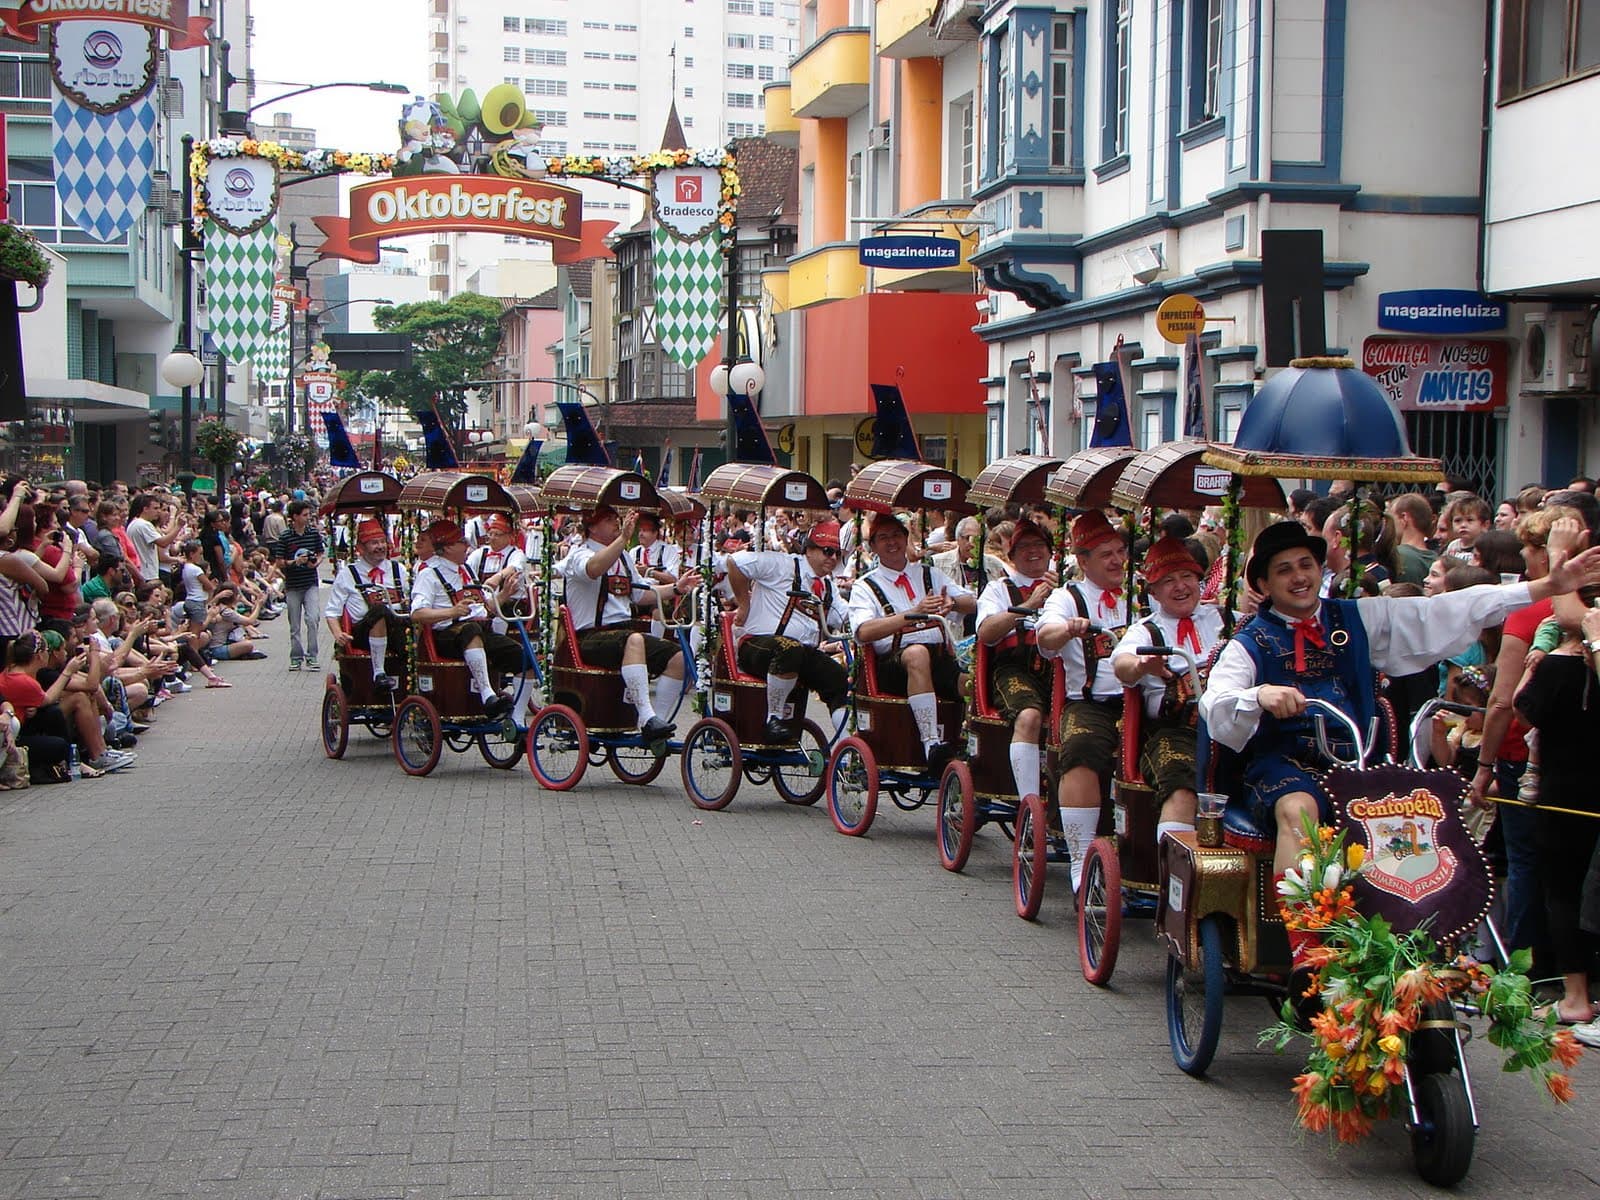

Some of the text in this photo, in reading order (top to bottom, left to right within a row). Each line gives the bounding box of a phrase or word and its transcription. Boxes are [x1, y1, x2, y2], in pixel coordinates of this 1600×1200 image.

[367, 184, 567, 229] Oktoberfest
[663, 206, 714, 216] Bradesco
[864, 247, 955, 259] magazineluiza
[1384, 304, 1500, 319] magazineluiza
[1365, 343, 1489, 368] CONHEÇA NOSSO
[1417, 366, 1492, 405] MÓVEIS
[1198, 474, 1232, 489] BRAHM
[1353, 793, 1442, 818] Centopéia
[1369, 866, 1449, 895] LUMENAU BRASIL
